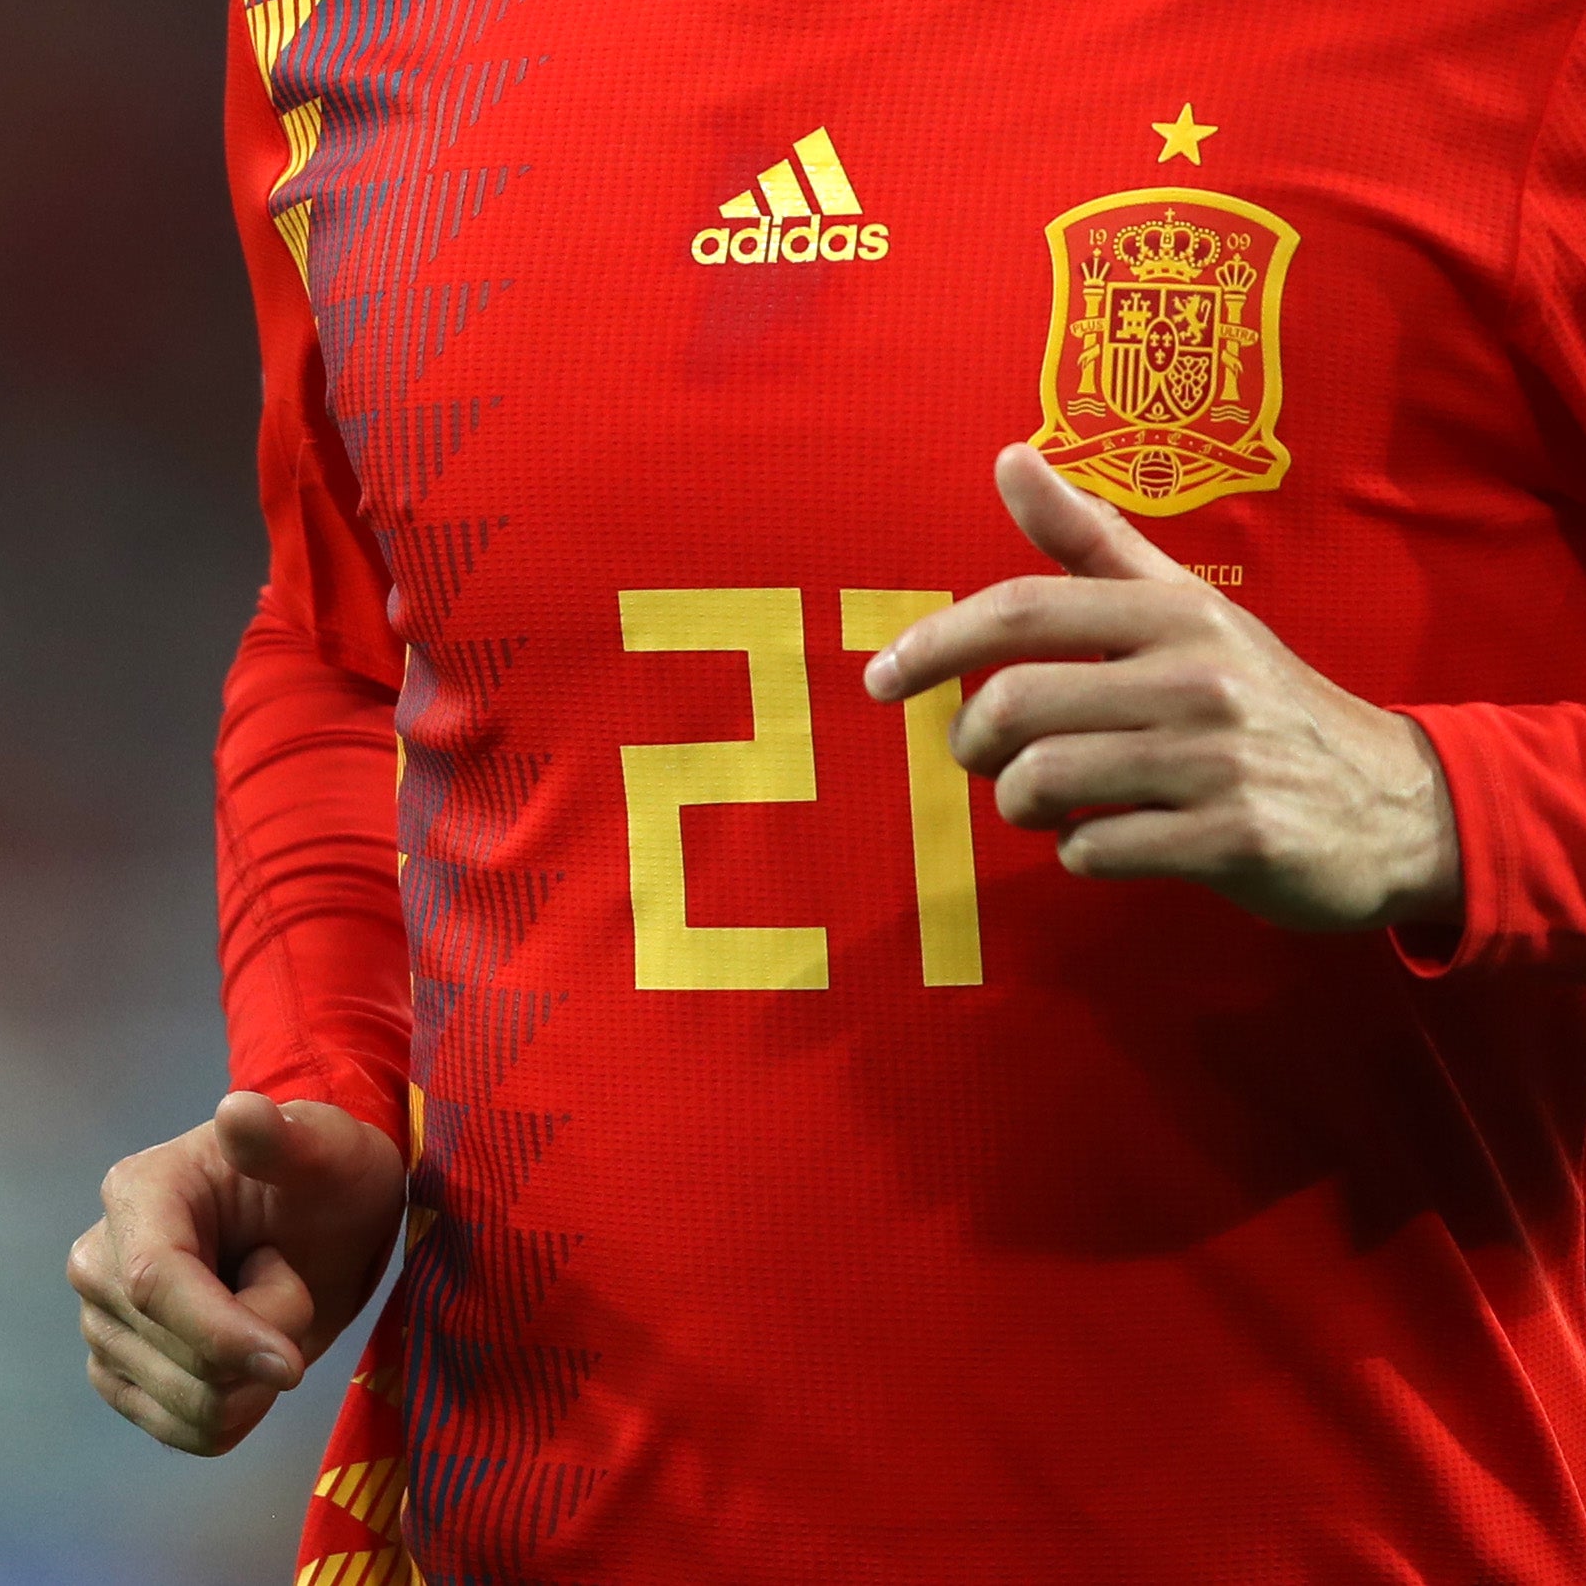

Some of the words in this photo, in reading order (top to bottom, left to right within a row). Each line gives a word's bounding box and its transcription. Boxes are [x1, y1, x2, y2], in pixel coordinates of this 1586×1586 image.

[690, 214, 890, 265] adidas
[1088, 228, 1108, 246] 19
[1226, 232, 1252, 251] 09
[1072, 320, 1104, 334] PLUS
[1183, 564, 1244, 586] OCCO
[618, 587, 984, 991] 21
